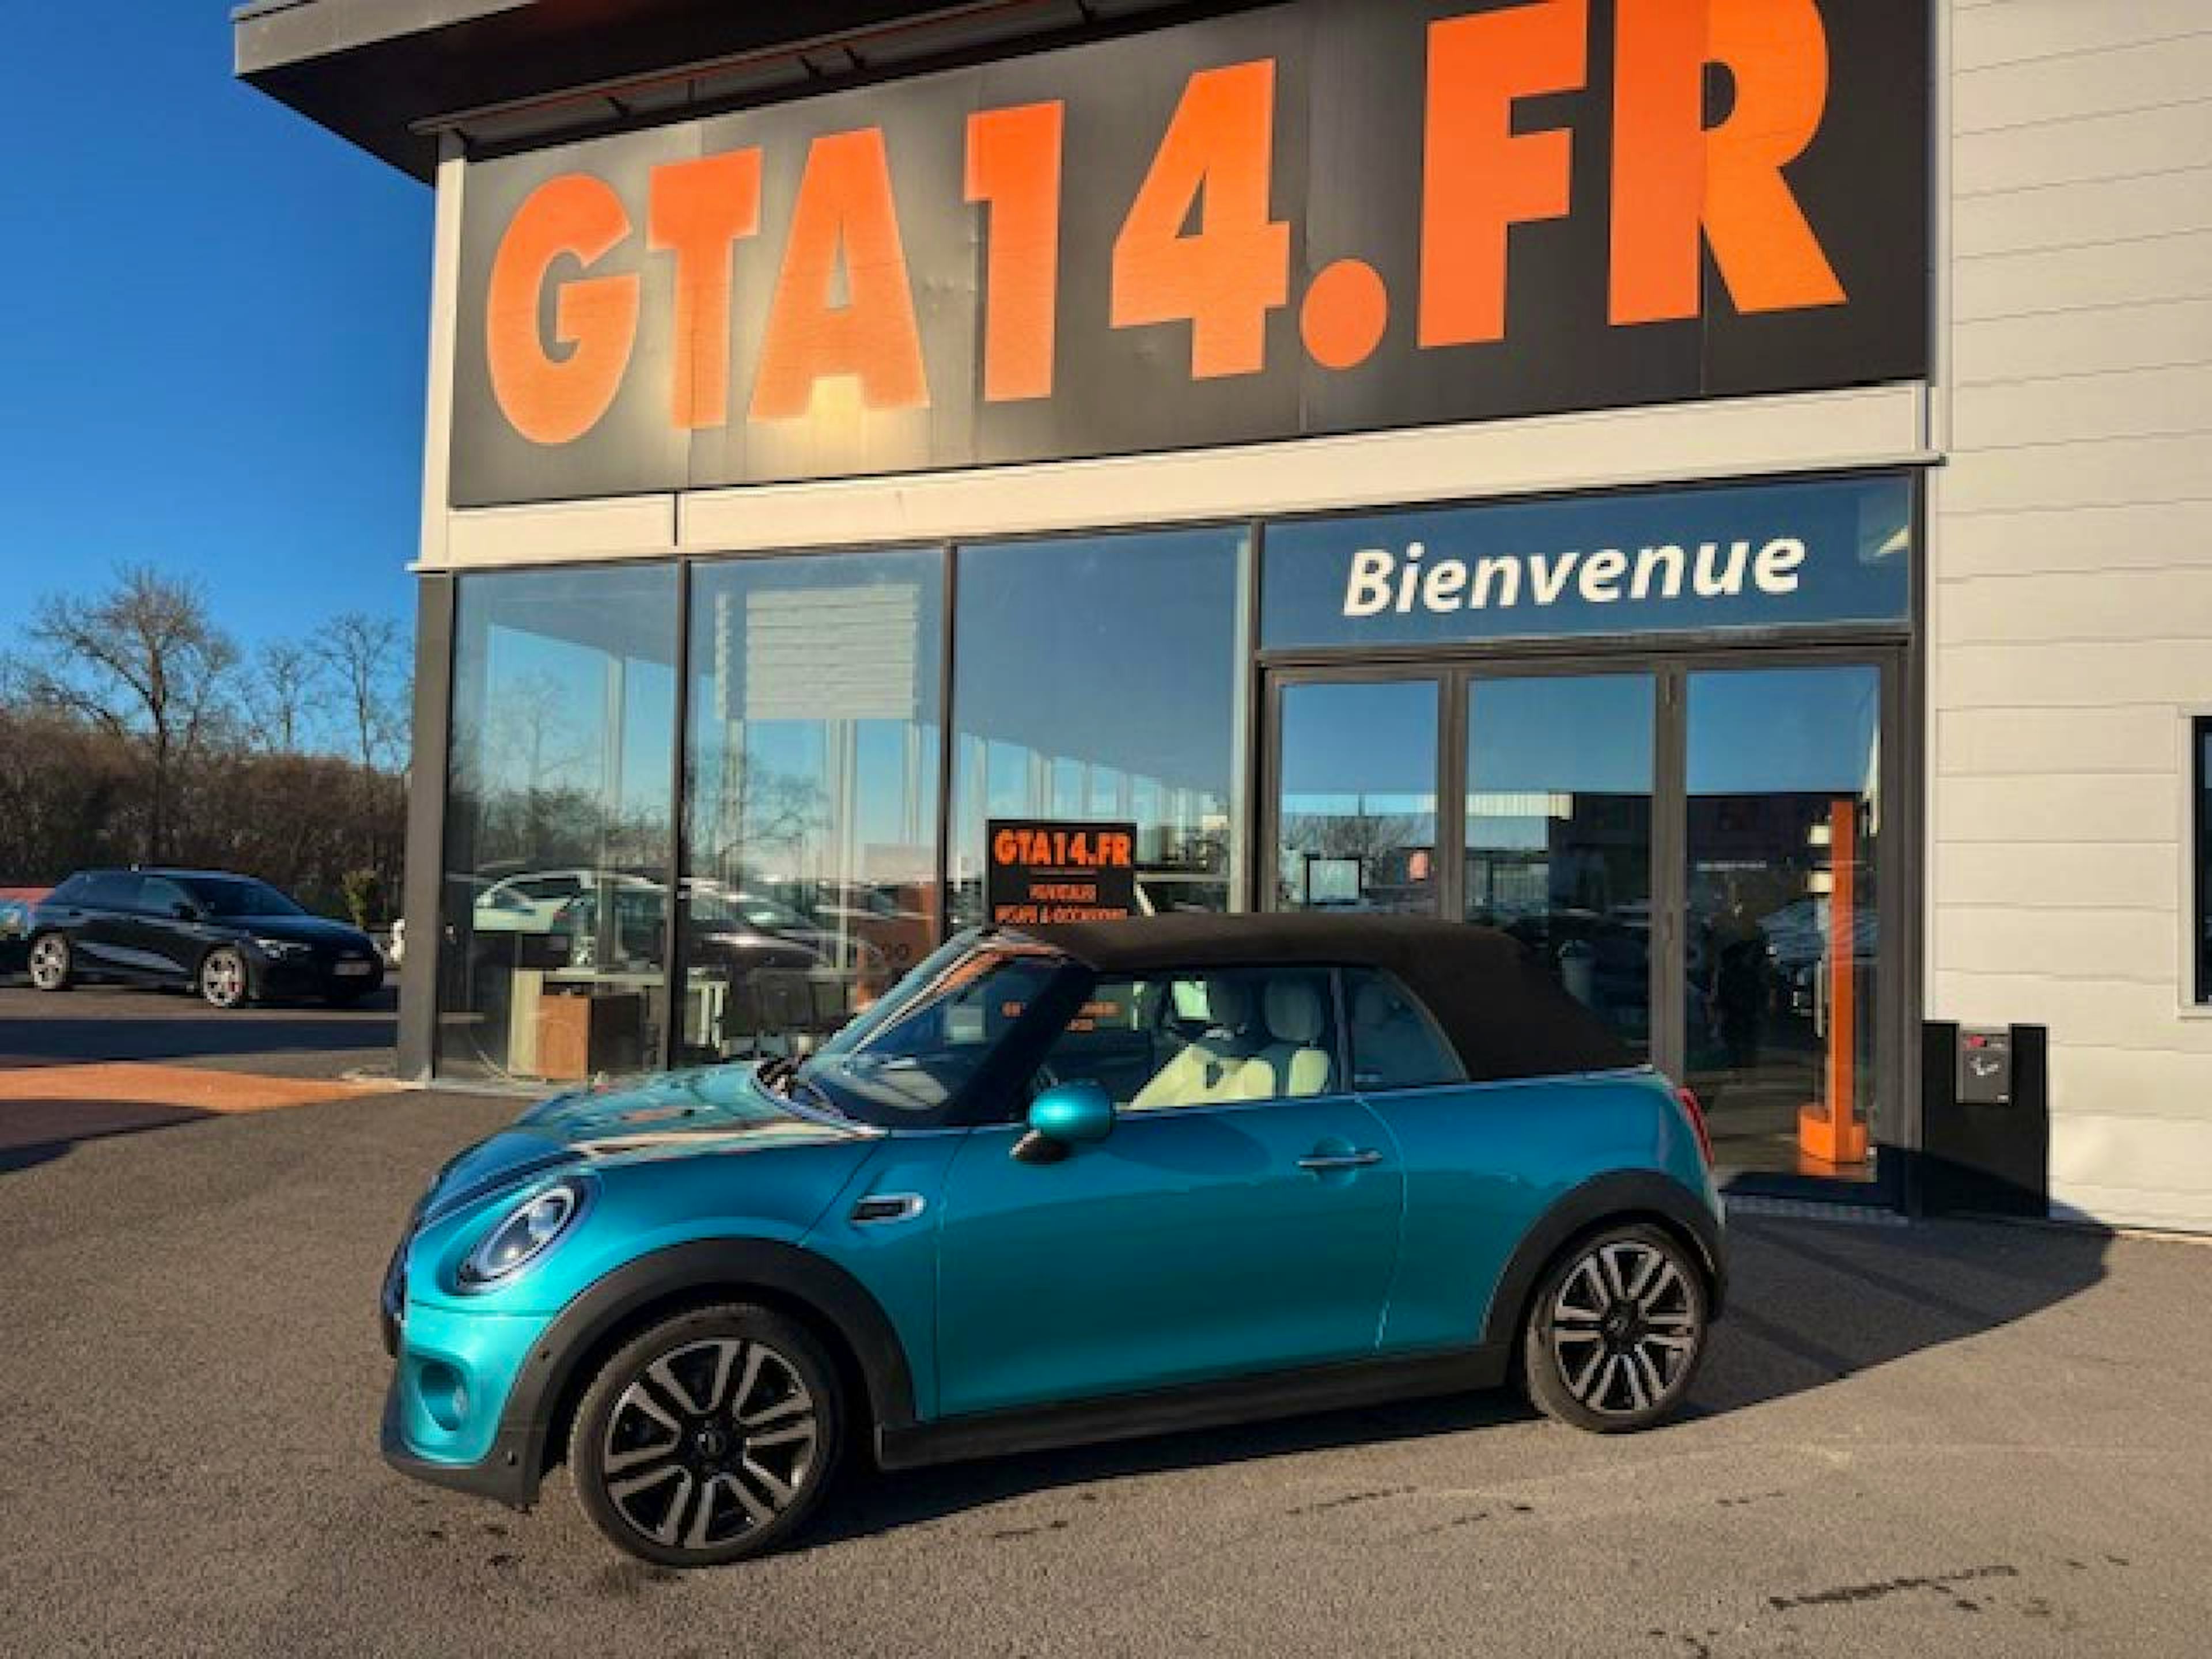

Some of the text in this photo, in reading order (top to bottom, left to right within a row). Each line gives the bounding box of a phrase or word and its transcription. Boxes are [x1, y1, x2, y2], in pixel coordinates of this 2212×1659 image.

[487, 0, 1846, 444] GTA14.FR
[1343, 537, 1806, 616] Bienvenue
[994, 829, 1131, 866] GTA14.FR
